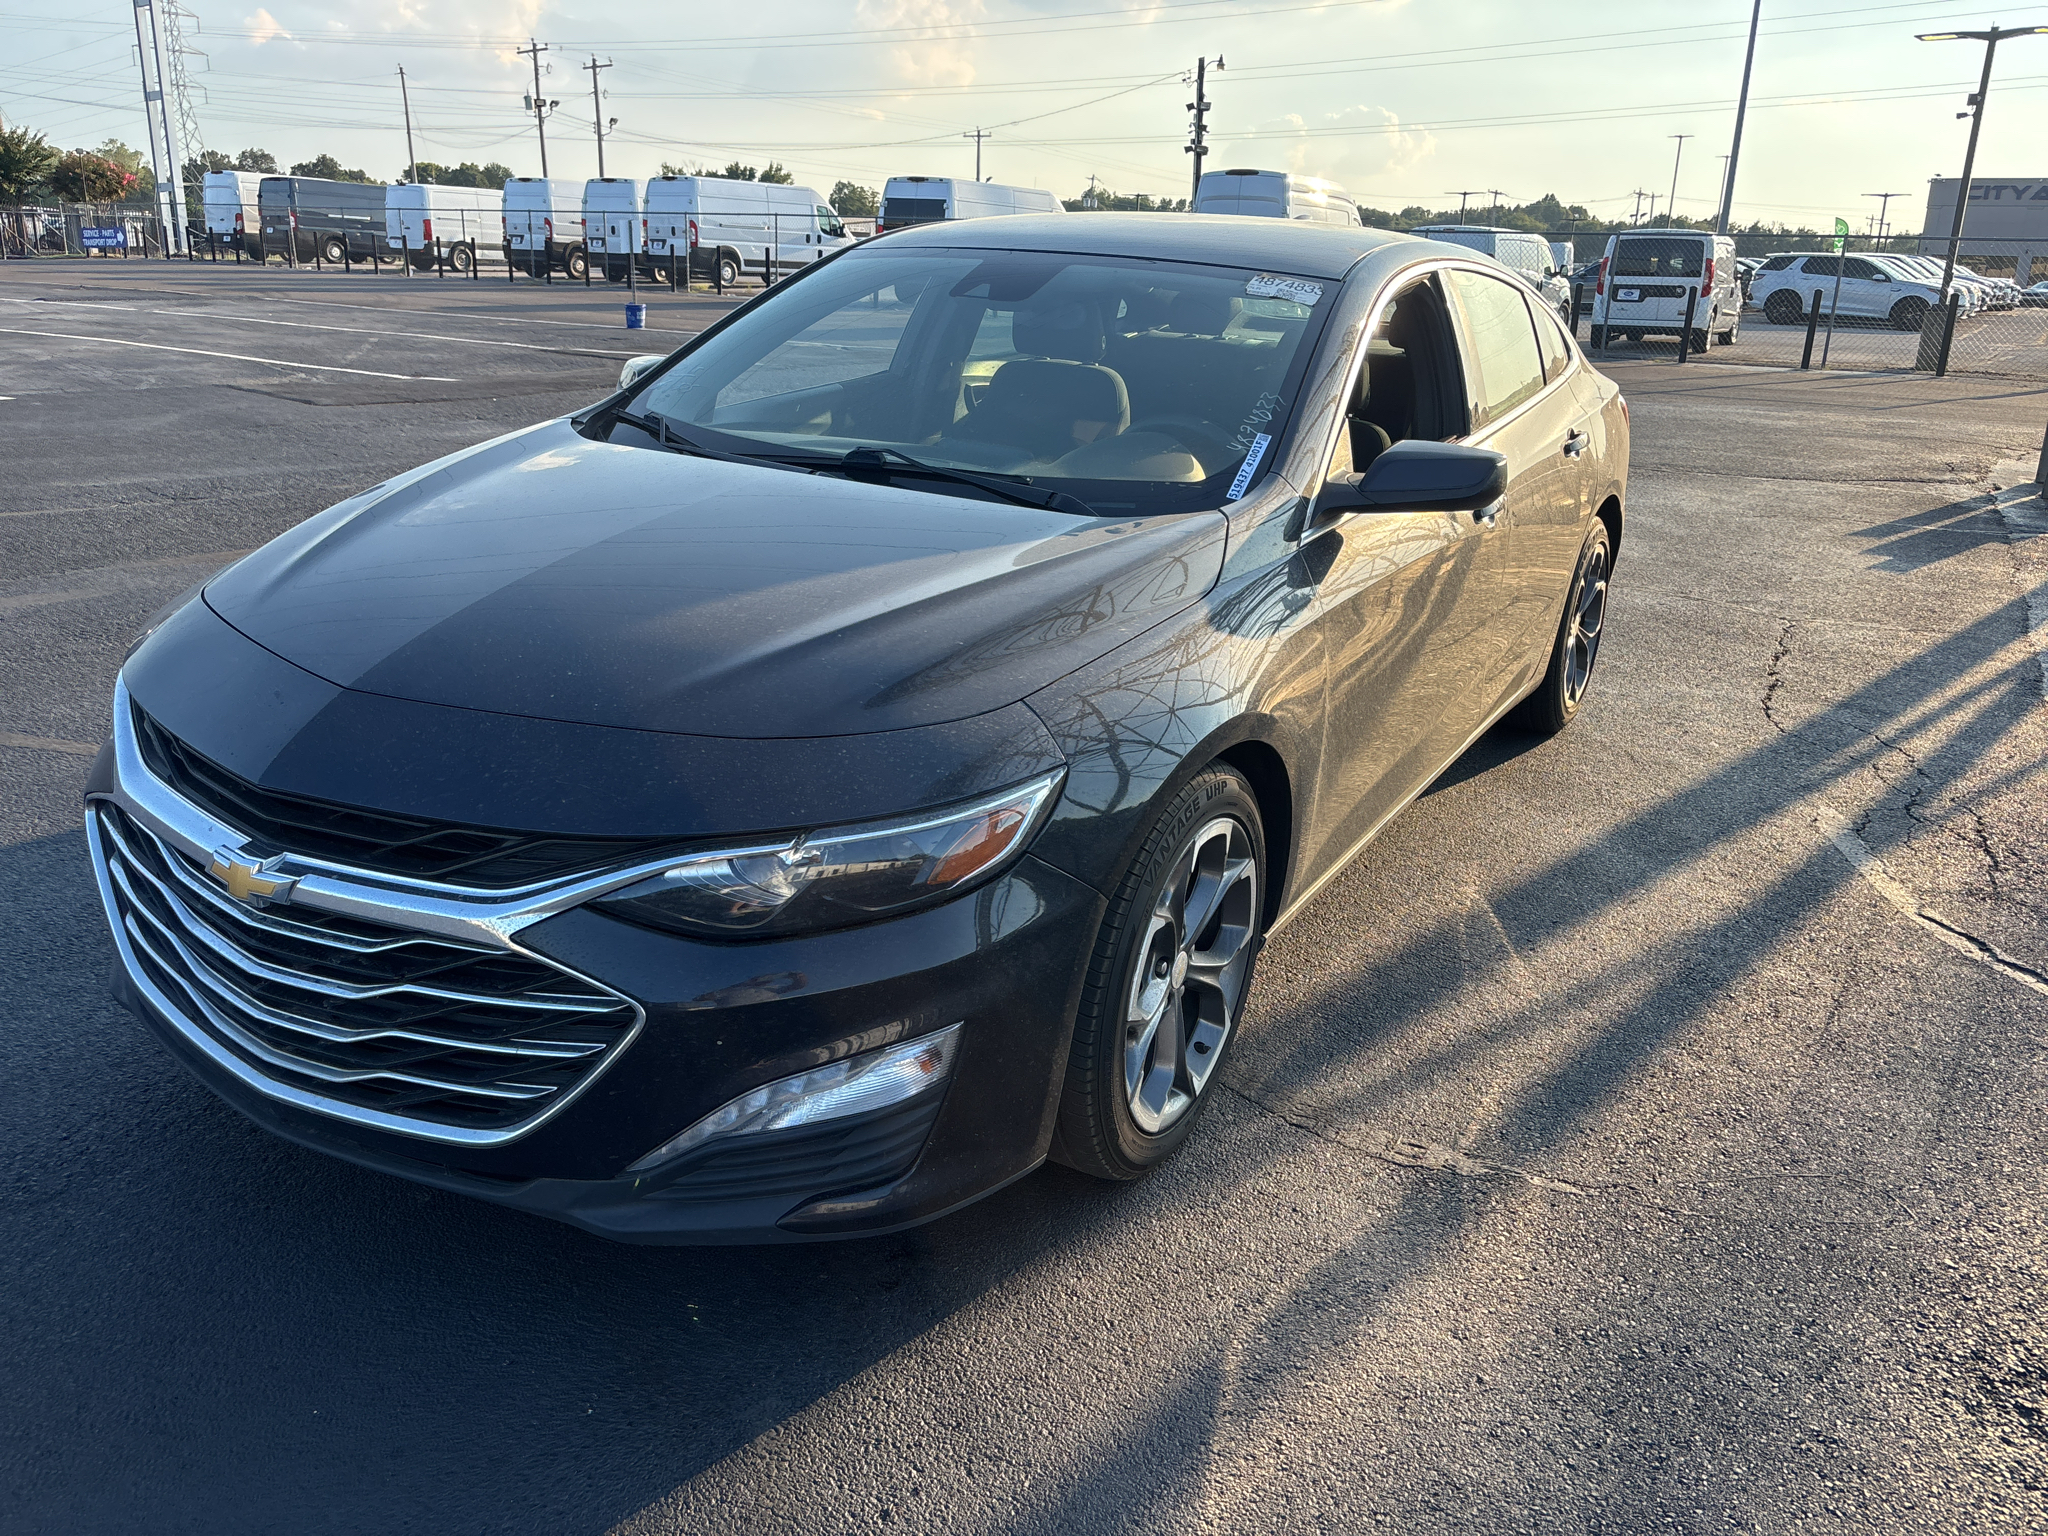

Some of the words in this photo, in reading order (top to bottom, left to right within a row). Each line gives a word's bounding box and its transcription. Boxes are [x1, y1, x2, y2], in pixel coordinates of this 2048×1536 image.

[83, 229, 99, 238] SERVICE
[102, 229, 115, 237] PARTS
[83, 238, 105, 246] TRANSPORT
[1255, 276, 1324, 296] 4874833
[1228, 470, 1250, 499] 519437
[1143, 796, 1201, 888] VANTAGE
[1205, 780, 1228, 801] UHP
